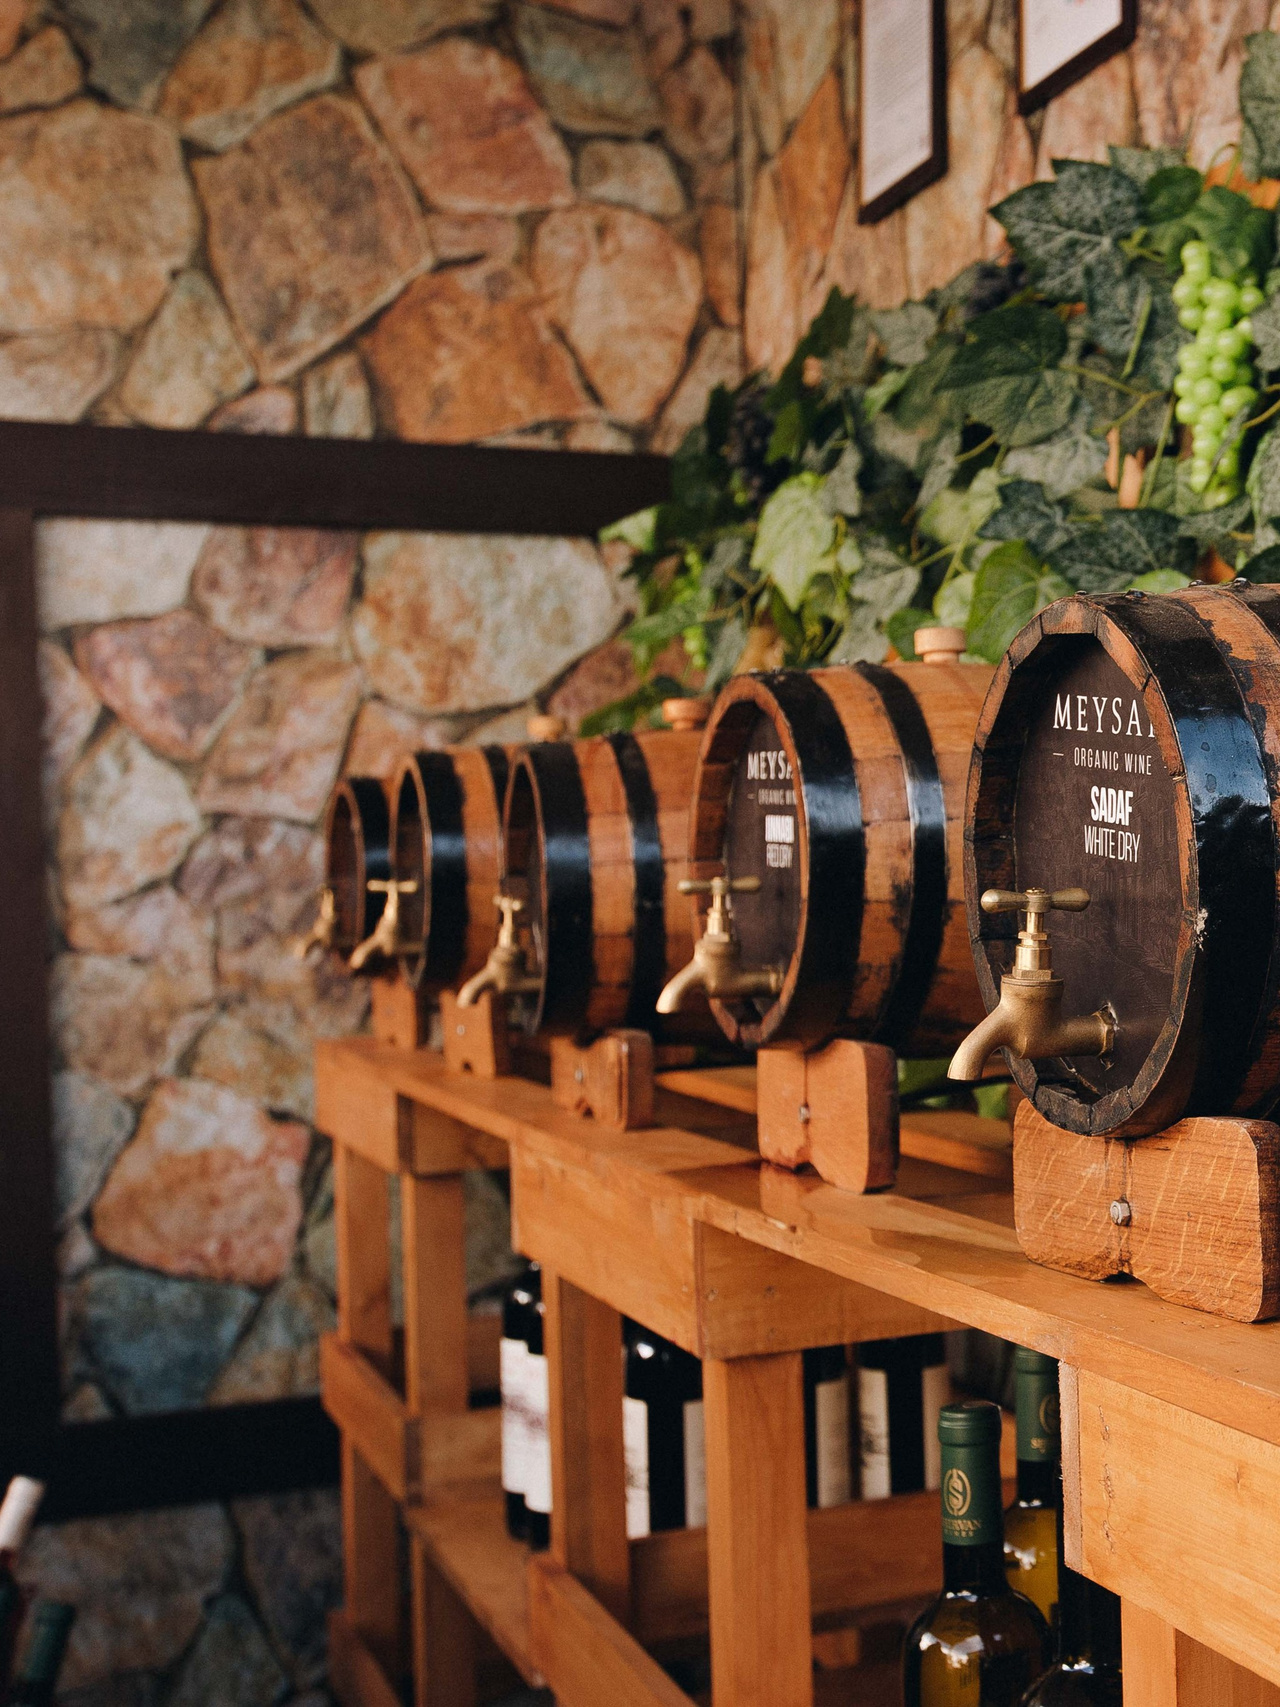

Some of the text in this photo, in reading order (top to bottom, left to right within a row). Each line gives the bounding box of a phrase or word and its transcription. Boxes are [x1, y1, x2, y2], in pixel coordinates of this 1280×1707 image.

[1052, 693, 1155, 738] MEYSA
[1074, 747, 1152, 775] ORGANIC WINE
[1090, 785, 1134, 826] SADAF
[1084, 824, 1141, 863] WHITE DRY
